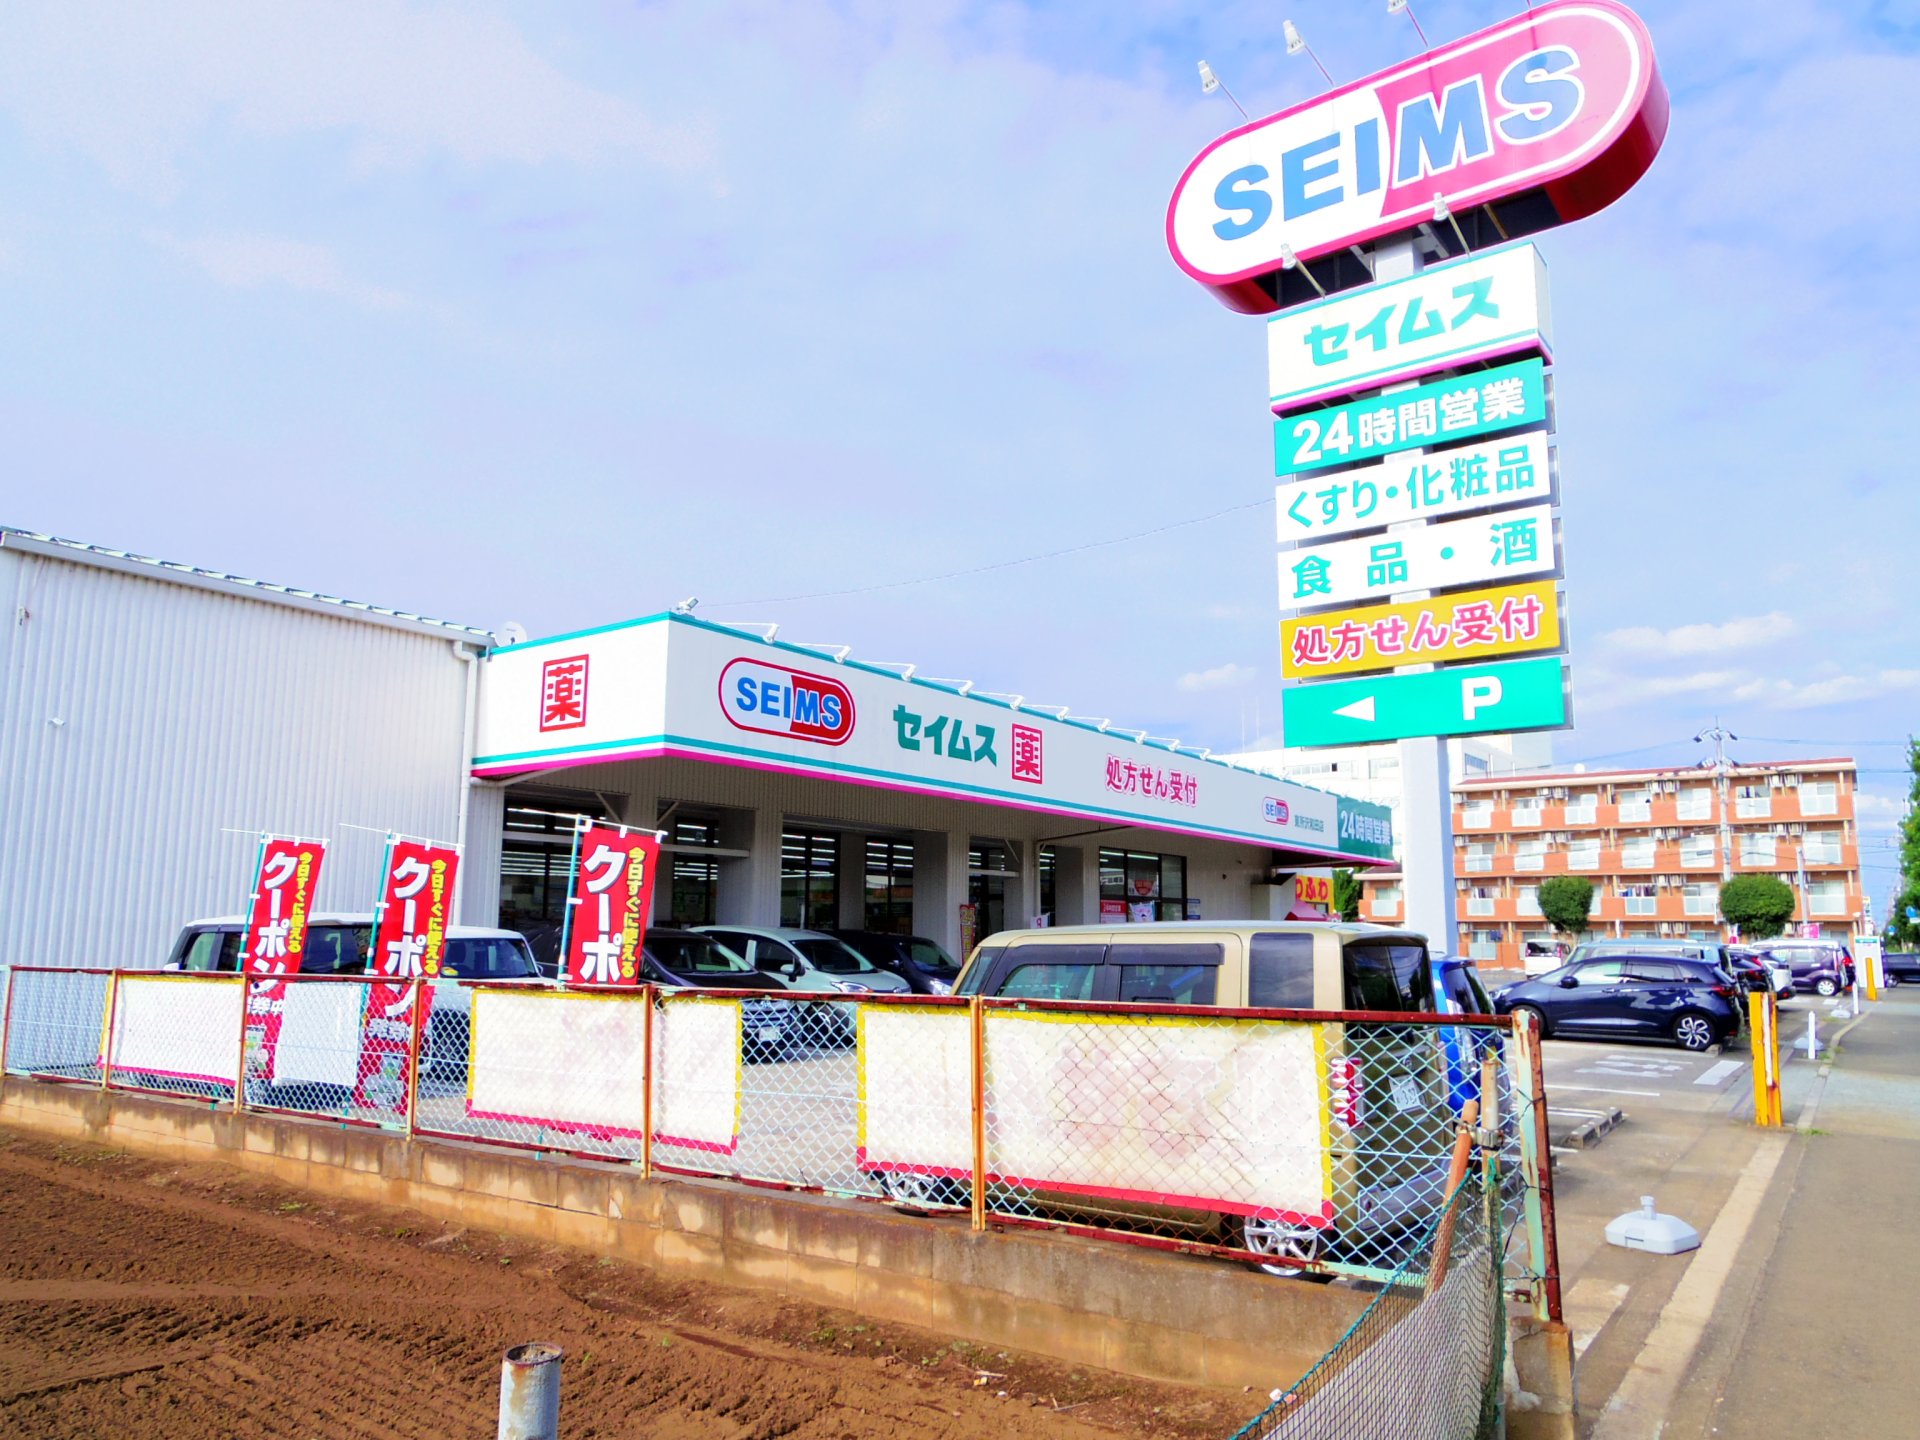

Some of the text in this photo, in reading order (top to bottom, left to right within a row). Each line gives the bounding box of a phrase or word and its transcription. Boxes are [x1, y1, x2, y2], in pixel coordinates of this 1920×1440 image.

[1212, 45, 1586, 241] SEIMS
[1303, 276, 1500, 366] セイムス
[1291, 377, 1525, 465] 24時間営業
[1287, 444, 1535, 529] くすり・化粧品
[1292, 596, 1543, 666] 処方せん受付
[545, 662, 583, 723] 薬
[735, 675, 843, 730] SEIMS
[1461, 675, 1503, 721] P
[892, 703, 998, 767] セイムス
[1014, 729, 1041, 778] 薬
[1105, 753, 1198, 806] 処方せん受付
[1265, 802, 1287, 819] SEIMS
[1340, 810, 1391, 846] 24時間営業
[250, 851, 299, 995] クーポン
[424, 859, 448, 976] 今日すぐに使える
[621, 846, 646, 979] 今日すぐに使える
